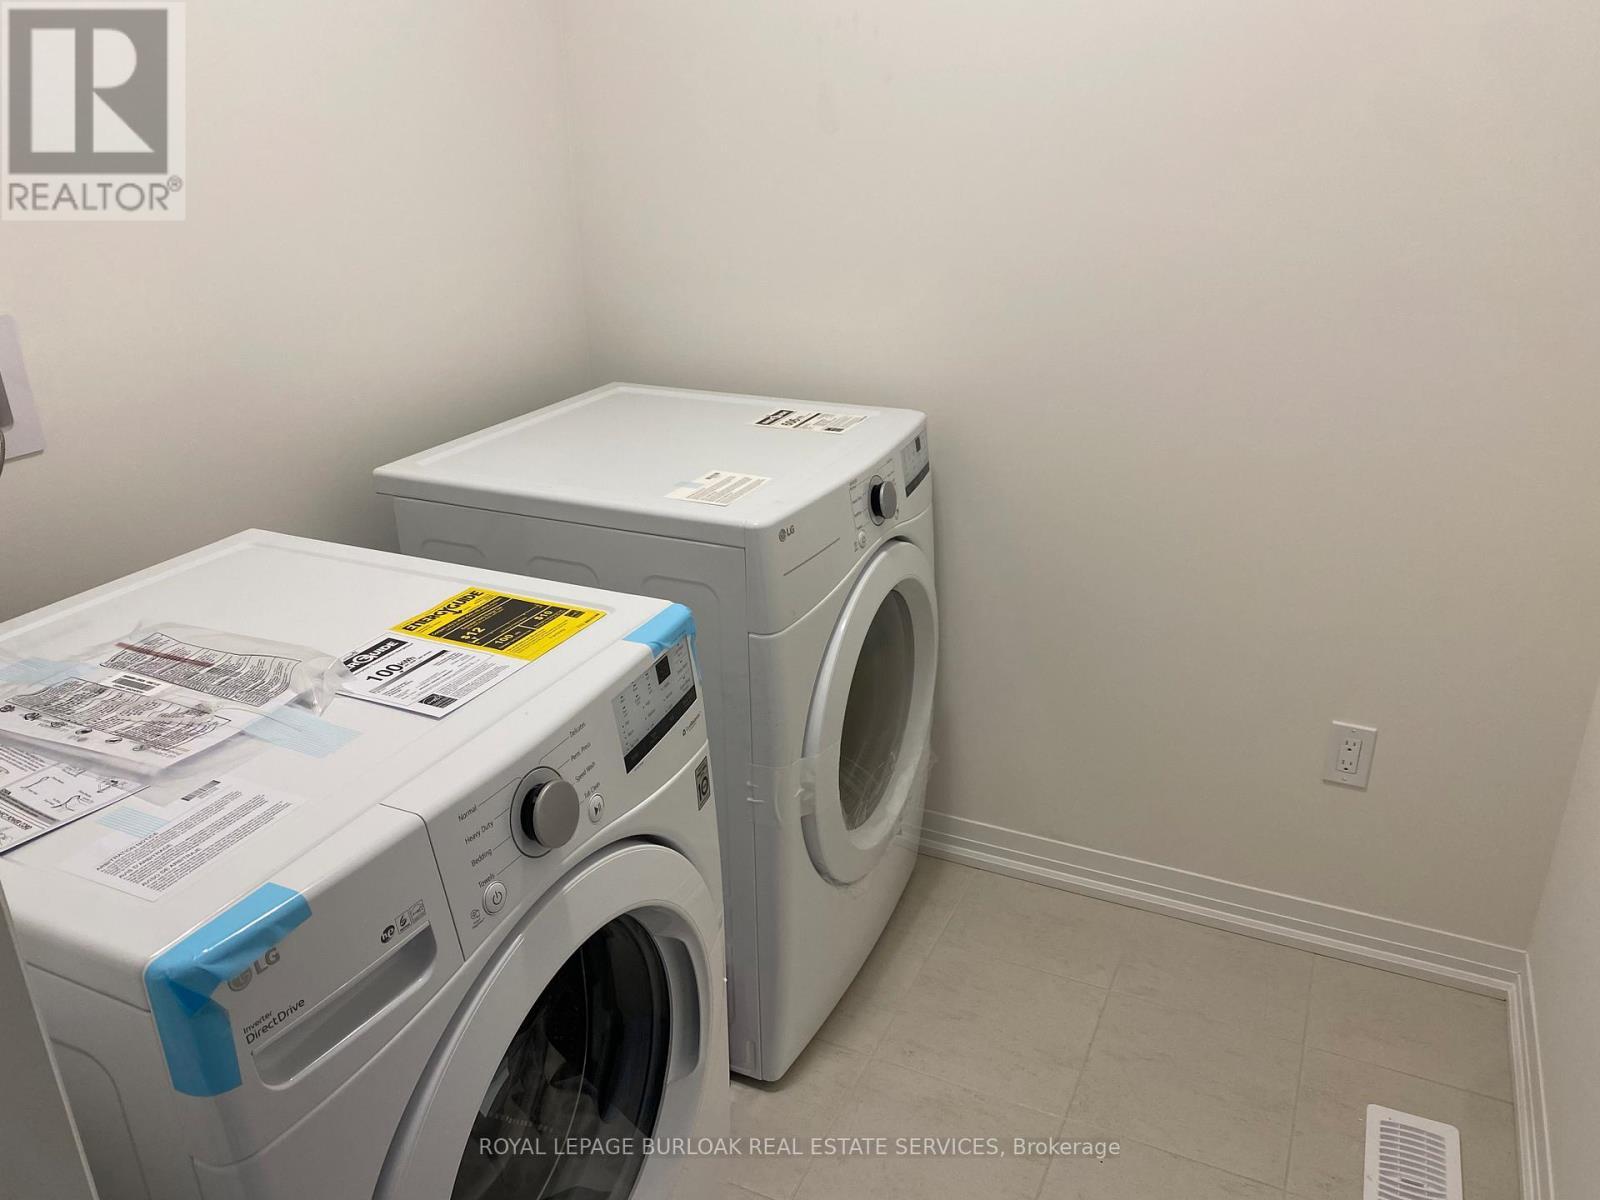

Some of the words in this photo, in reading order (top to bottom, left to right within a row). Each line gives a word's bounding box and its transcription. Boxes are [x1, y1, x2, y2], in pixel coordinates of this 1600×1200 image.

[786, 525, 795, 537] LG
[461, 627, 486, 640] $12
[495, 634, 514, 645] 100
[366, 664, 404, 682] 100
[458, 804, 478, 823] Normal
[464, 829, 481, 845] Heavy
[481, 820, 494, 836] Duty
[471, 848, 493, 868] Bedding
[478, 872, 496, 888] Towels
[254, 946, 281, 975] LG
[243, 1009, 273, 1035] Inverter
